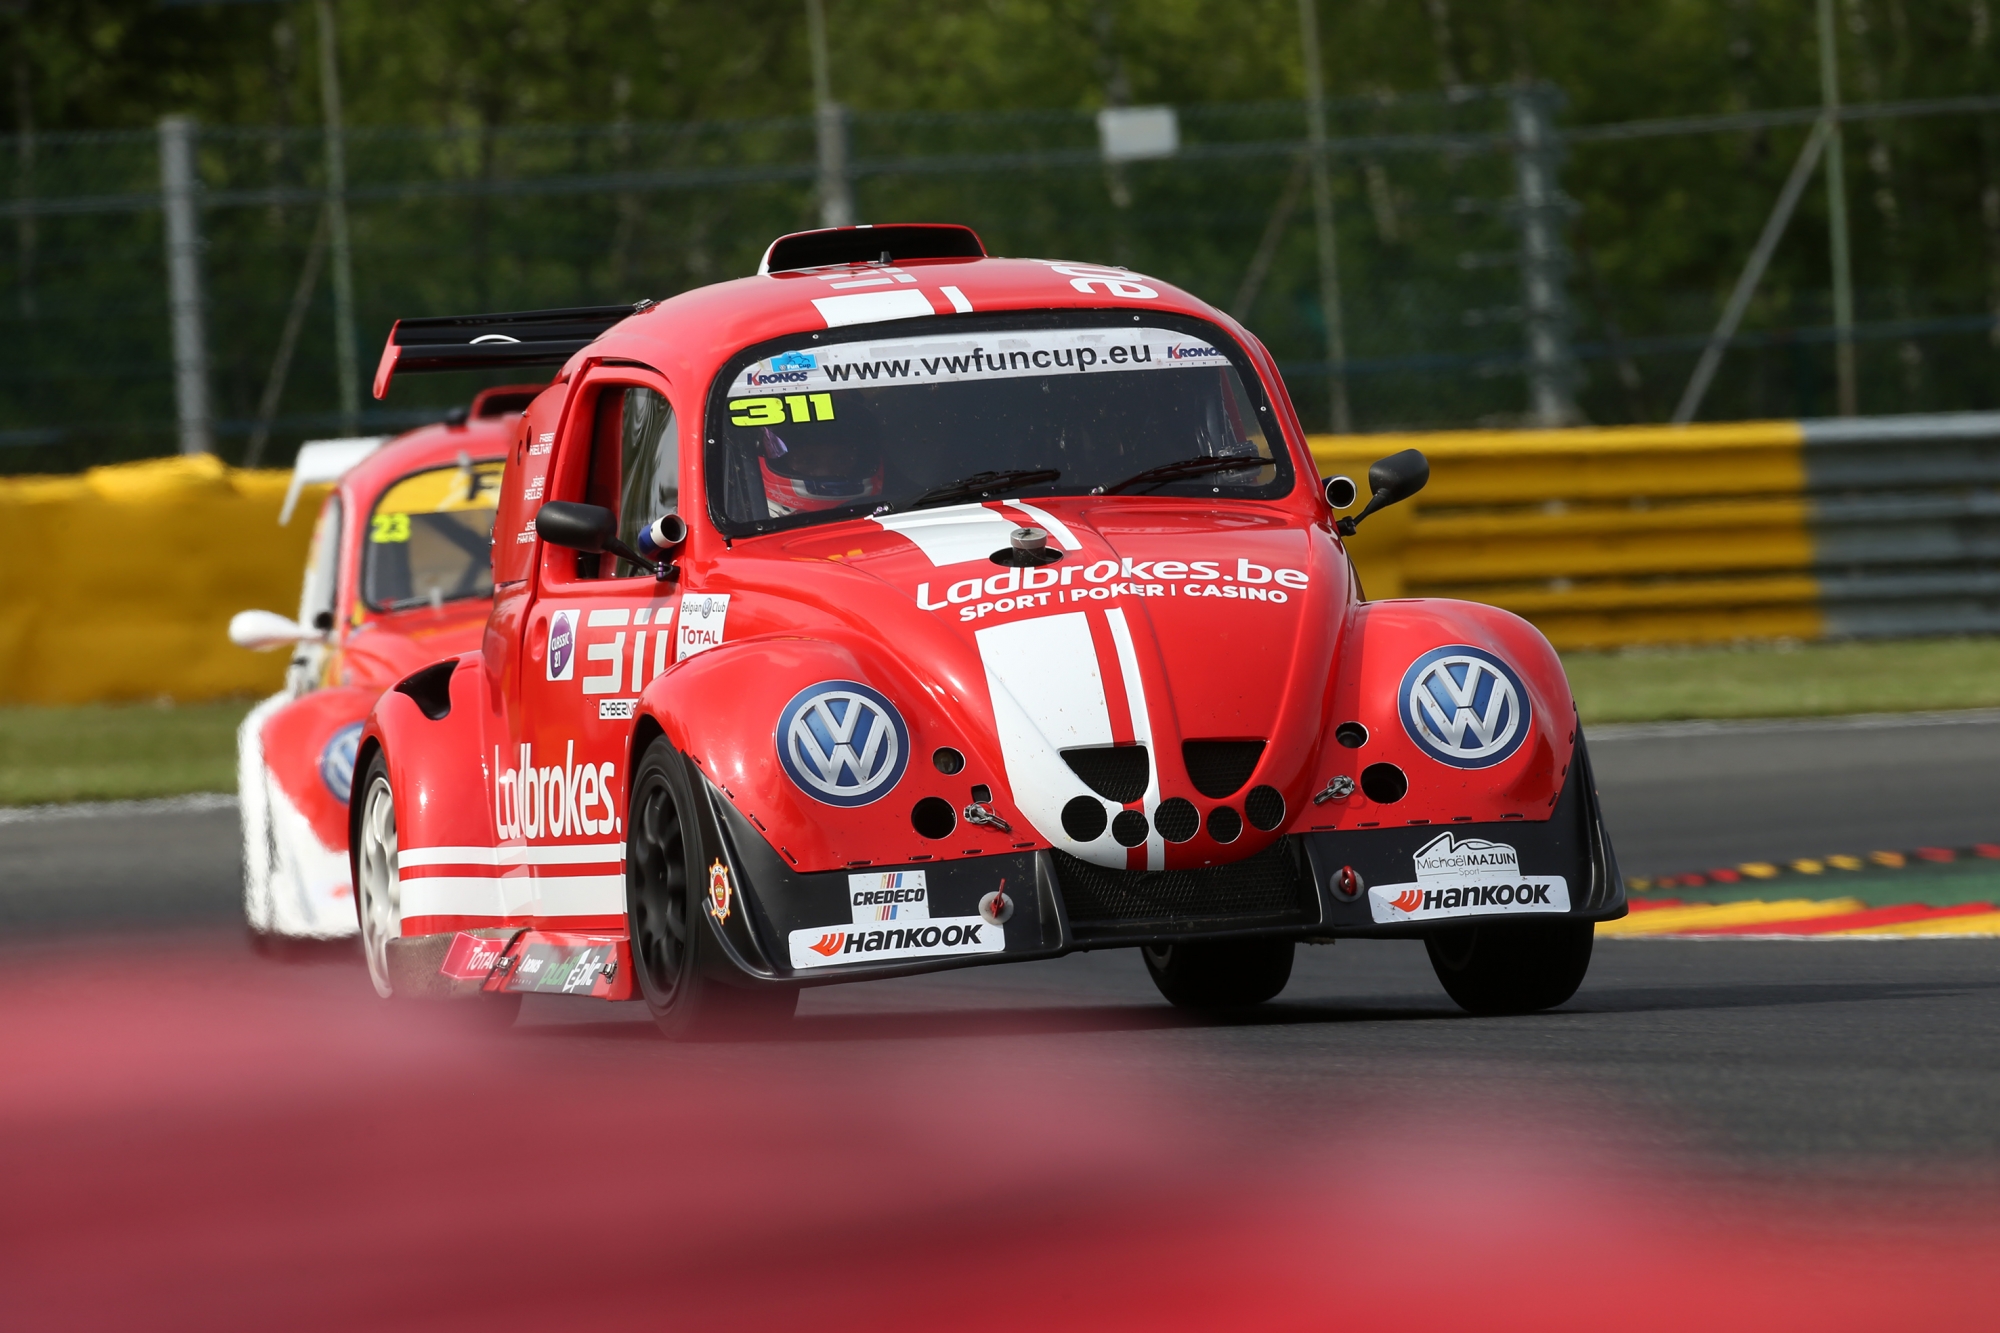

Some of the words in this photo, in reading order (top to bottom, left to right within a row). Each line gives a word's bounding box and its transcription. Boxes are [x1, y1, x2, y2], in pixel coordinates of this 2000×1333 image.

[1167, 342, 1223, 359] KRONO
[823, 344, 1152, 382] www.vwfuncup.eu
[747, 369, 808, 386] KRONOS
[729, 393, 835, 427] 311
[370, 513, 411, 543] 23
[916, 557, 1310, 611] Ladbrokes.be
[682, 601, 702, 615] Belgian
[712, 601, 726, 613] Club
[960, 591, 1051, 622] SPORT
[1071, 583, 1164, 602] POKER
[1184, 584, 1288, 603] CASINO
[551, 631, 571, 651] CLASSIC
[681, 626, 719, 645] TOTAL
[583, 607, 674, 694] 311
[1459, 867, 1480, 878] Sport
[853, 889, 925, 906] CREDECO
